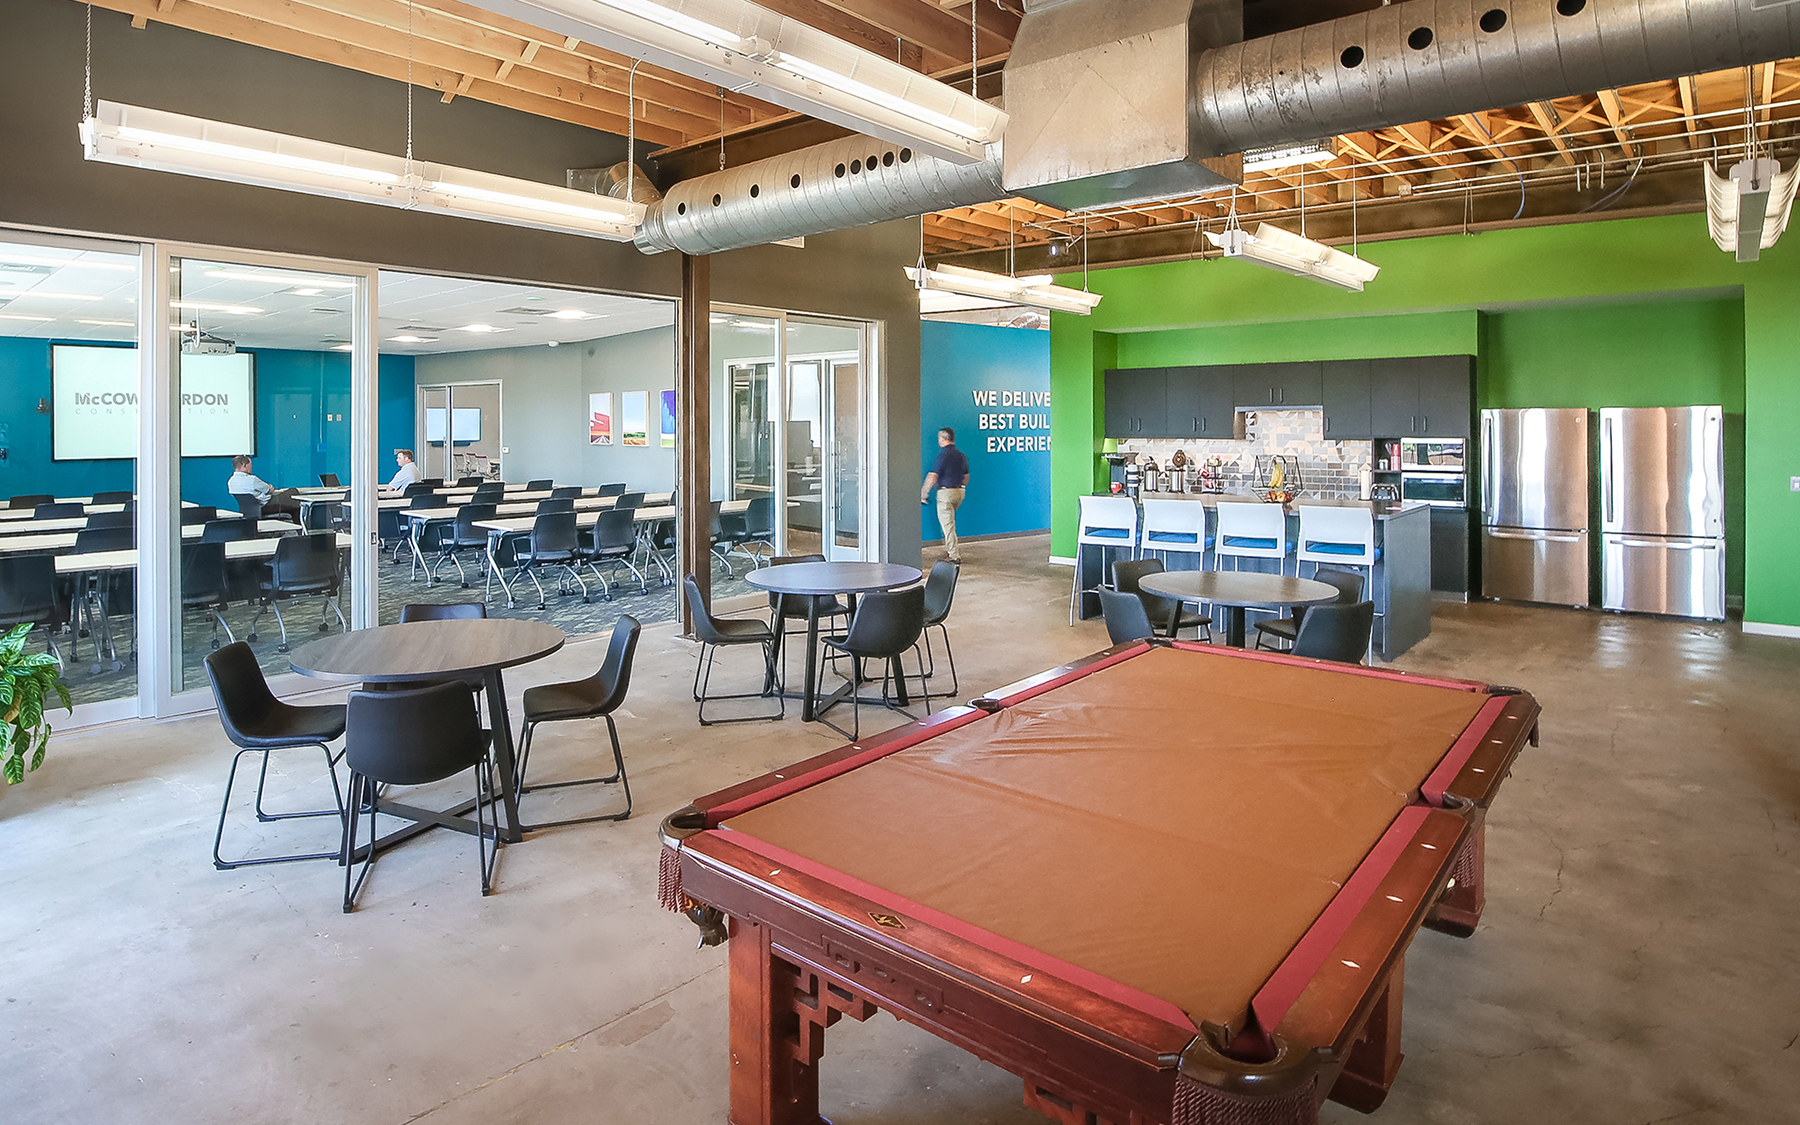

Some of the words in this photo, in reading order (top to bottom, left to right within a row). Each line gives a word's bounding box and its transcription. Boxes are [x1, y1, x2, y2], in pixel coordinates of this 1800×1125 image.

[75, 392, 228, 406] McCOWRDON
[972, 390, 997, 407] WE
[1002, 390, 1051, 407] DELIVE
[979, 413, 1015, 430] BEST
[1019, 413, 1050, 430] BUIL
